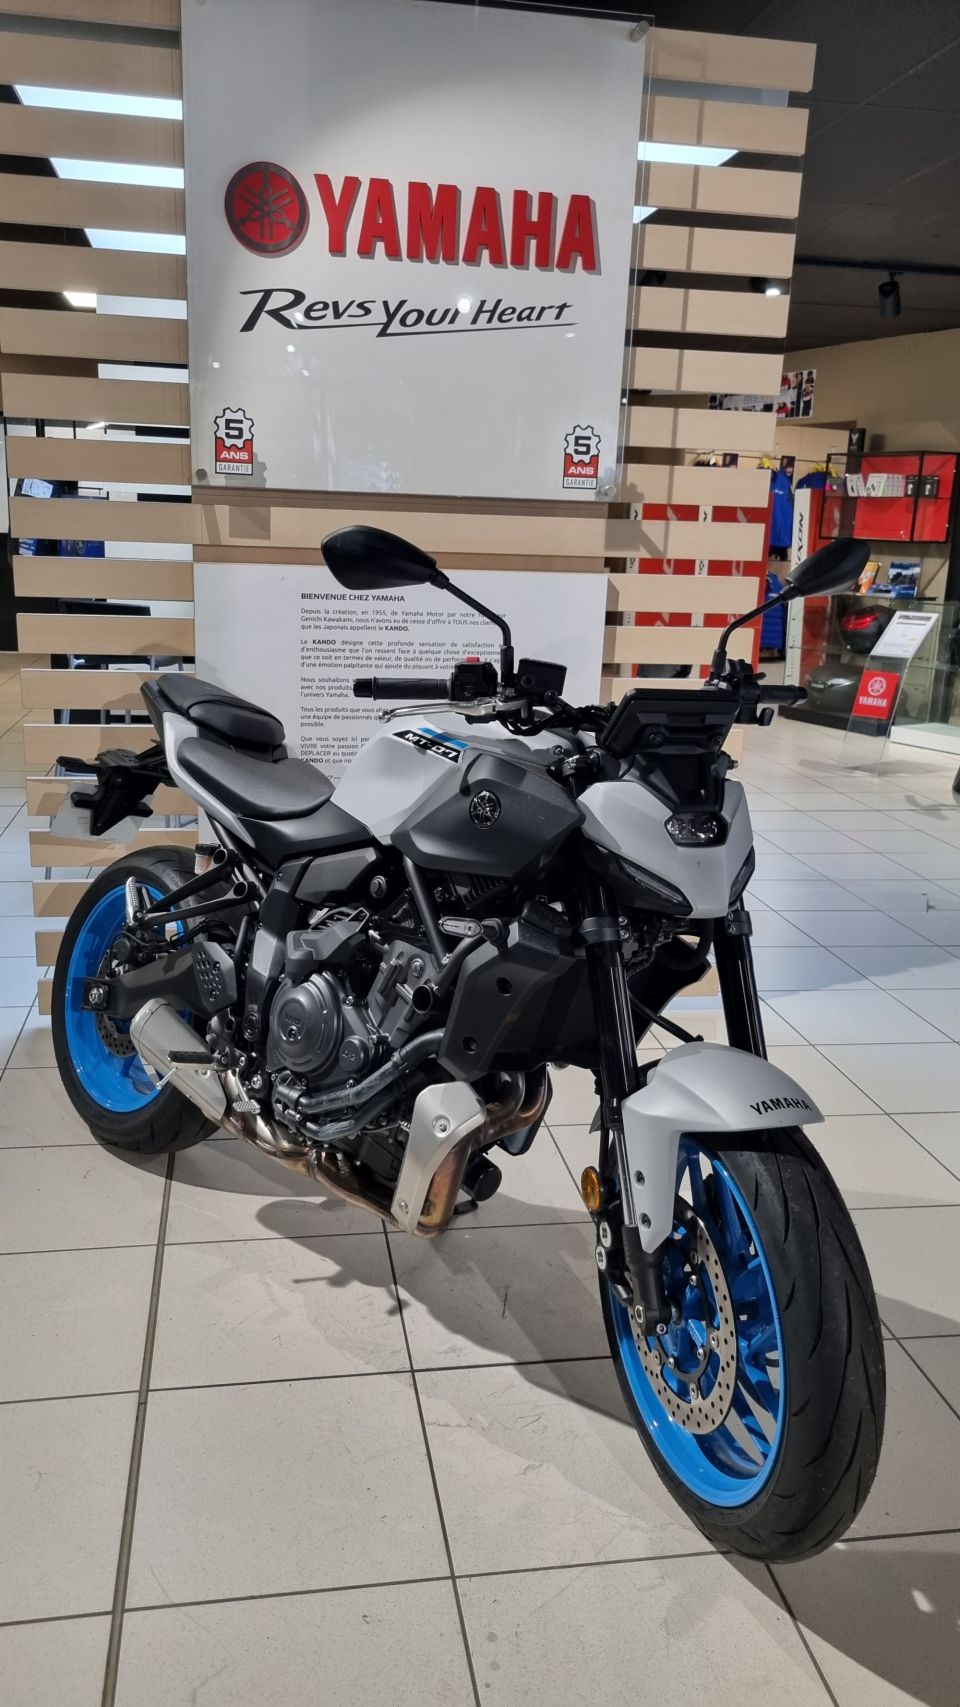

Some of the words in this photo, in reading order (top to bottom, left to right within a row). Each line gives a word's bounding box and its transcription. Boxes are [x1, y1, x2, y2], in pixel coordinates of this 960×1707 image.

[314, 173, 598, 272] YAMAHA
[240, 288, 376, 332] Revs
[376, 299, 463, 337] Your
[470, 298, 573, 325] Heart
[225, 418, 243, 440] 5
[574, 435, 591, 455] 5
[220, 451, 249, 460] ANS
[218, 464, 250, 473] GARANTIE
[568, 467, 594, 475] ANS
[565, 478, 595, 487] GARANTIE
[859, 695, 888, 708] YAMAHA
[404, 733, 458, 758] MT-07
[749, 1097, 813, 1115] YAMAHA
